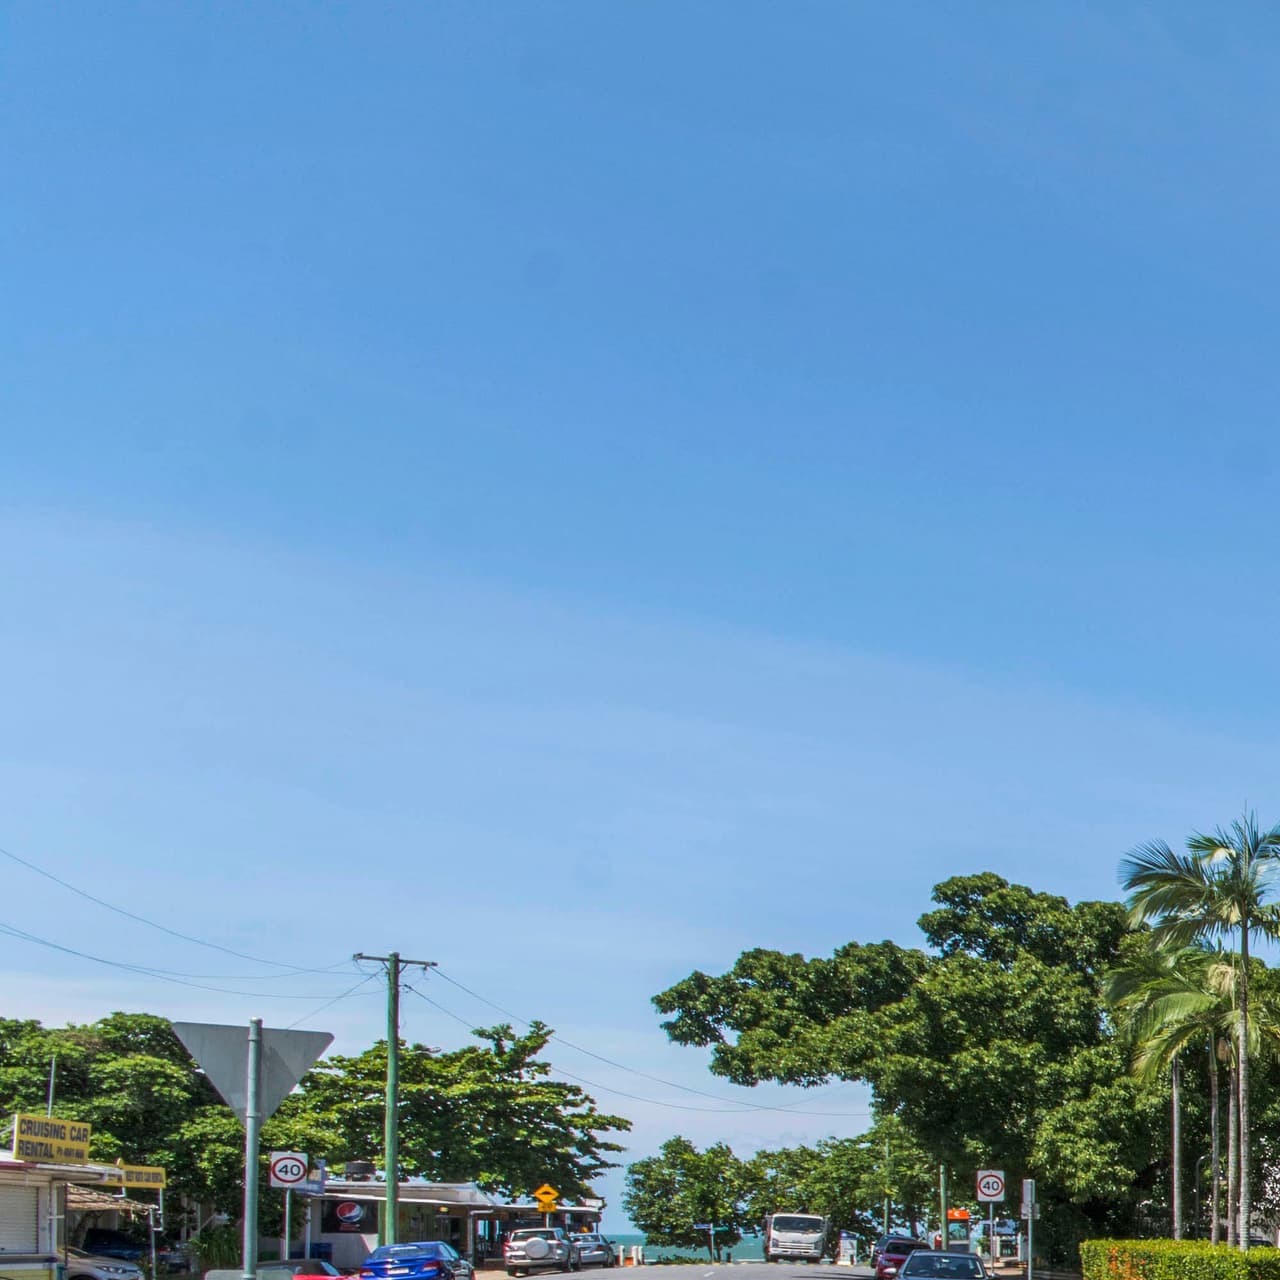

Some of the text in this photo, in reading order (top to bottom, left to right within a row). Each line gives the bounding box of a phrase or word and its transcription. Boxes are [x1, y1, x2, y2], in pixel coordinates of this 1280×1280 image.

[19, 1118, 89, 1143] CRUISING CAR
[18, 1139, 54, 1159] RENTAL
[278, 1164, 301, 1176] 40
[982, 1180, 1000, 1191] 40
